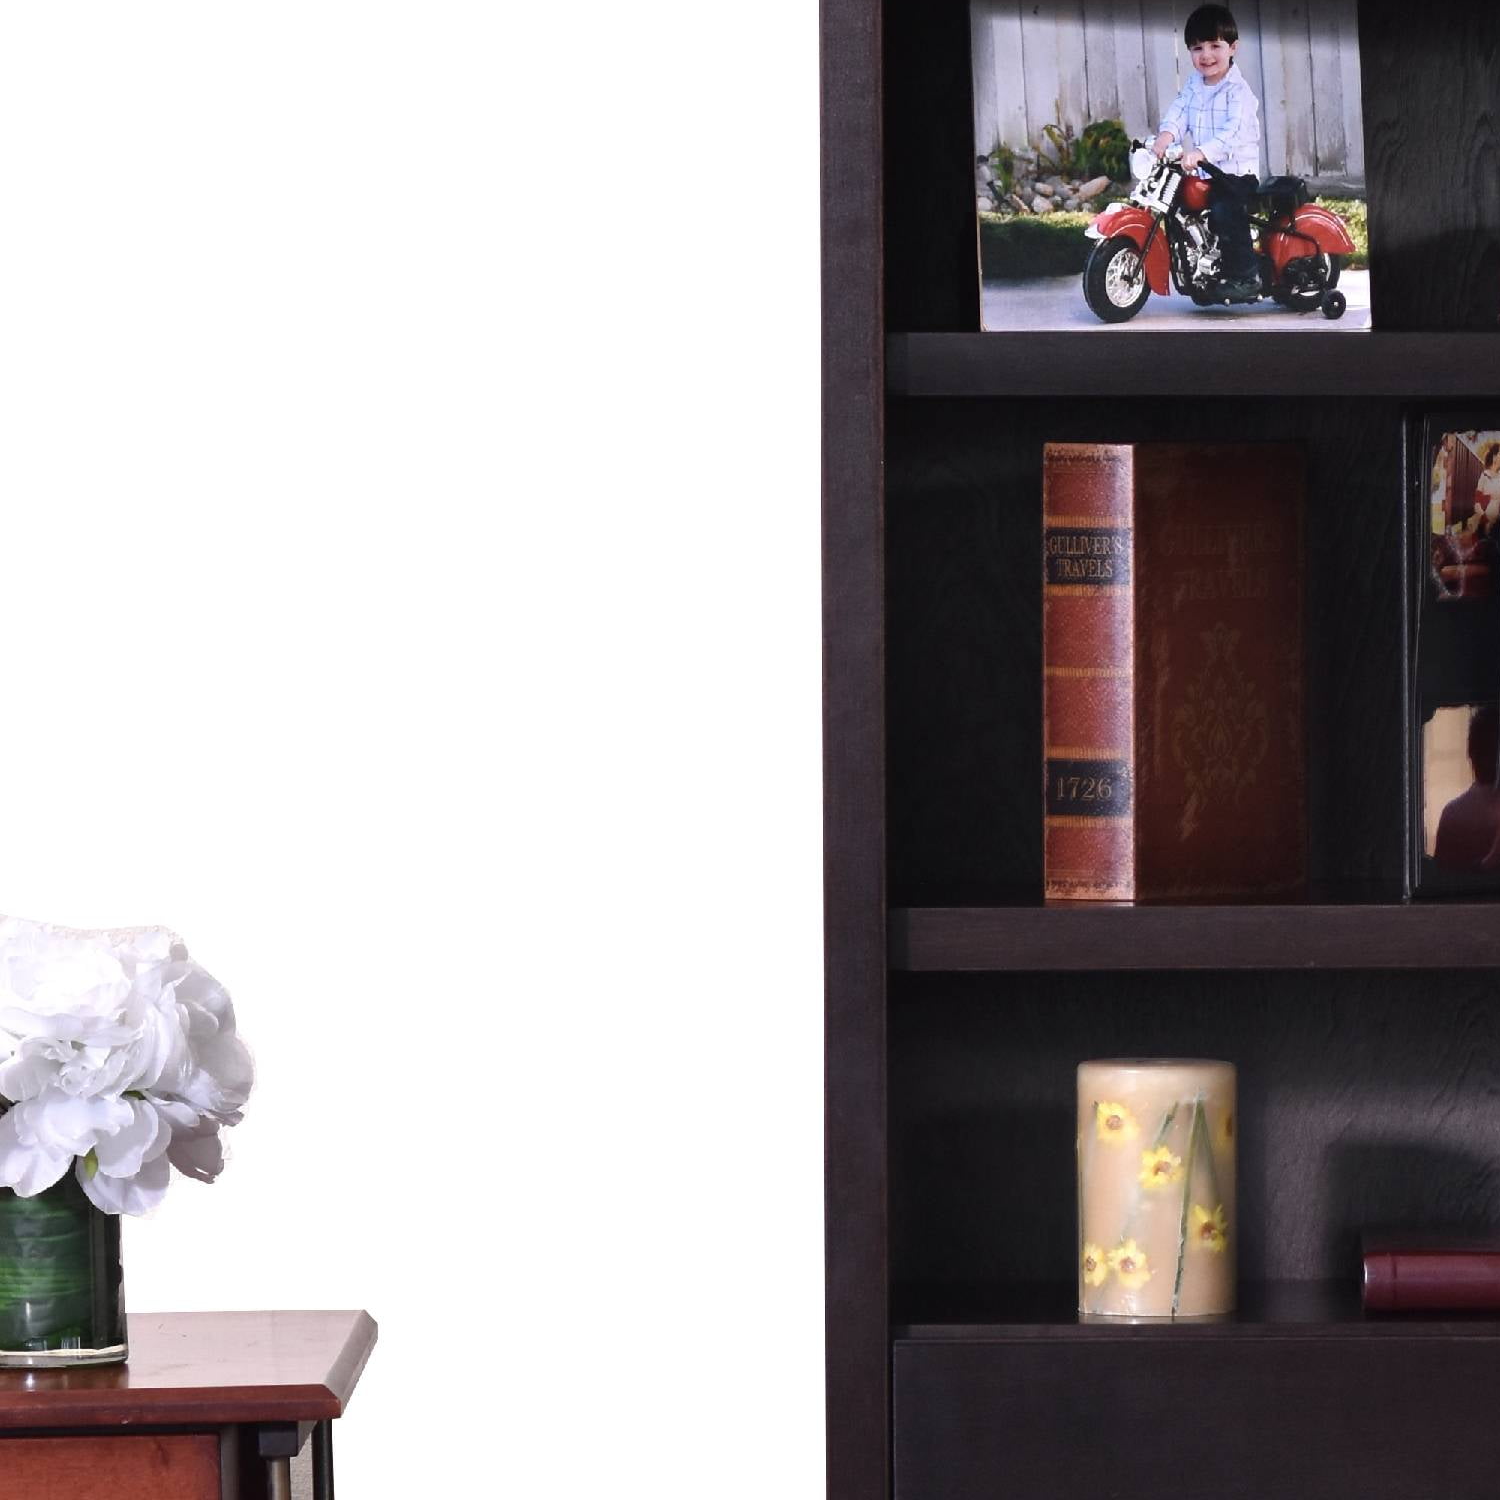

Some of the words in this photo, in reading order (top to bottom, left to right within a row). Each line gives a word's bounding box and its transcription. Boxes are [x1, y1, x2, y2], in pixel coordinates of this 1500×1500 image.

[1050, 535, 1123, 555] GULLIVER'S
[1056, 559, 1113, 578] TRAVELS
[1057, 776, 1112, 799] 1726
